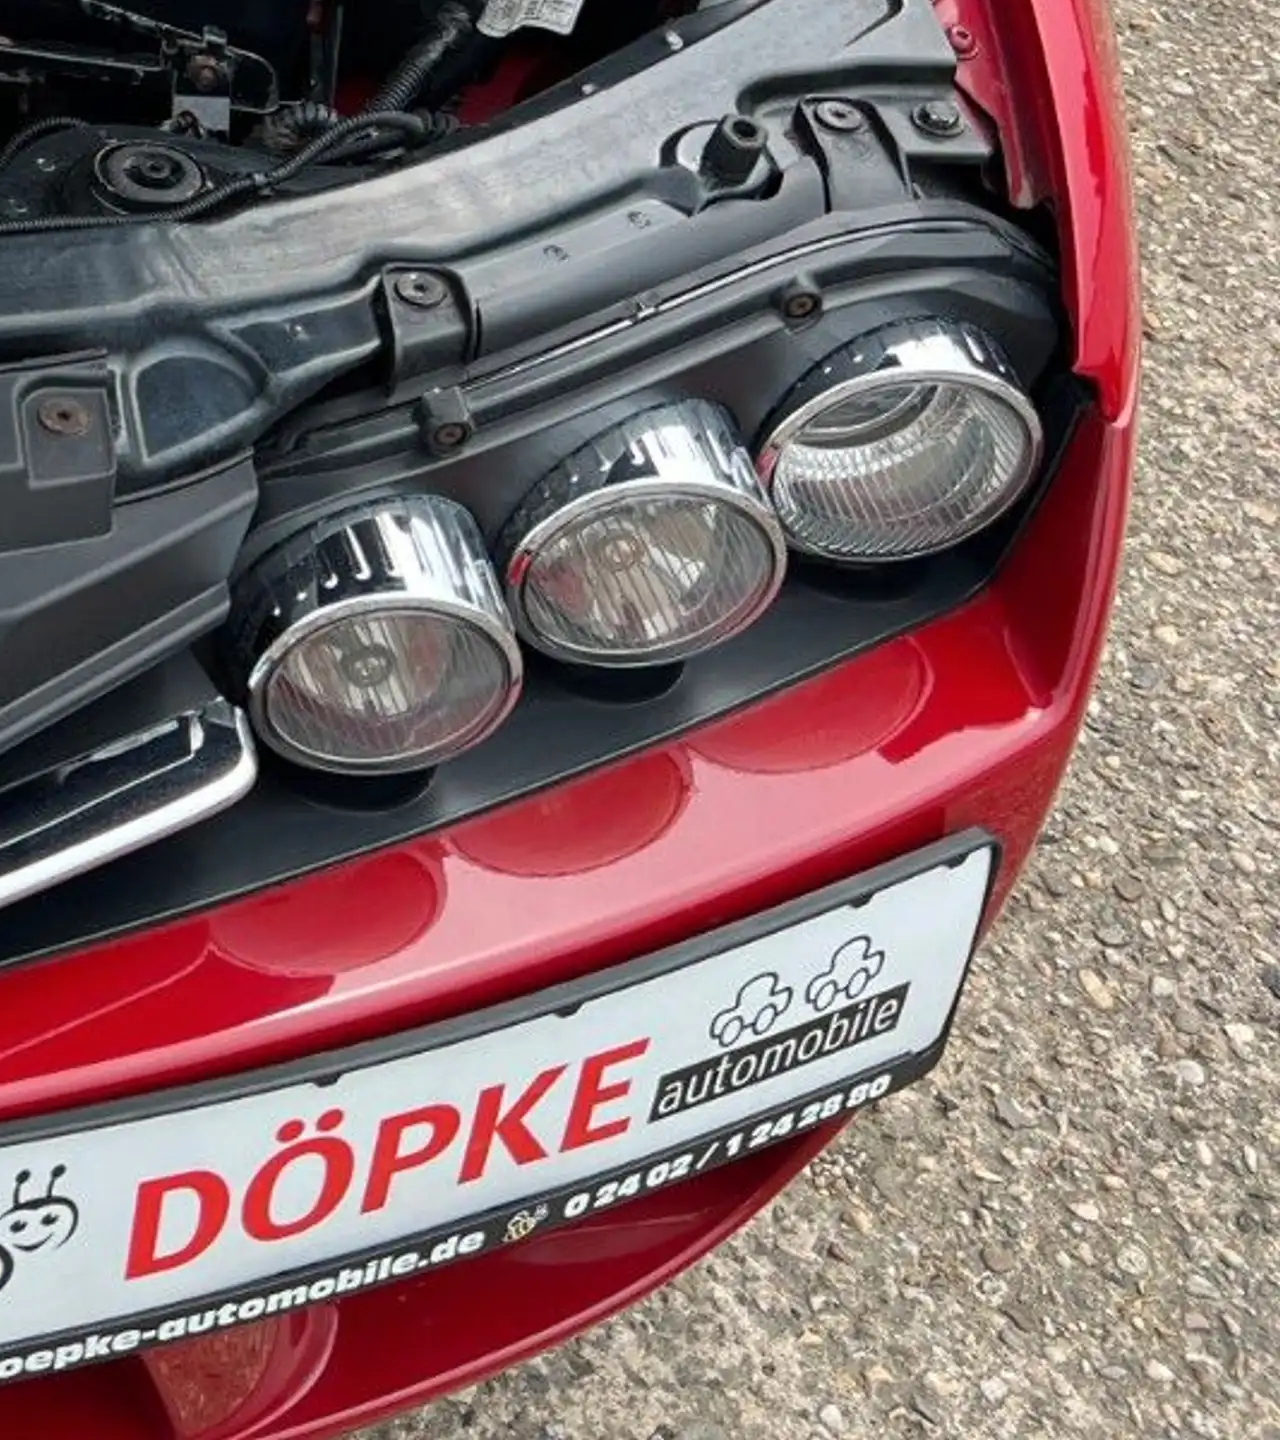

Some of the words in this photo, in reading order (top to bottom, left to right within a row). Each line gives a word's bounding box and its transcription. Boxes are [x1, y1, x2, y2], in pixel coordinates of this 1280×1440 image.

[656, 991, 900, 1113] automobile
[124, 1037, 650, 1281] DÖPKE
[564, 1192, 589, 1218] 0
[593, 1178, 642, 1208] 24
[646, 1154, 694, 1188] 02
[726, 1133, 745, 1158] 1
[748, 1116, 793, 1148] 24
[797, 1096, 842, 1128] 28
[846, 1074, 892, 1109] 80
